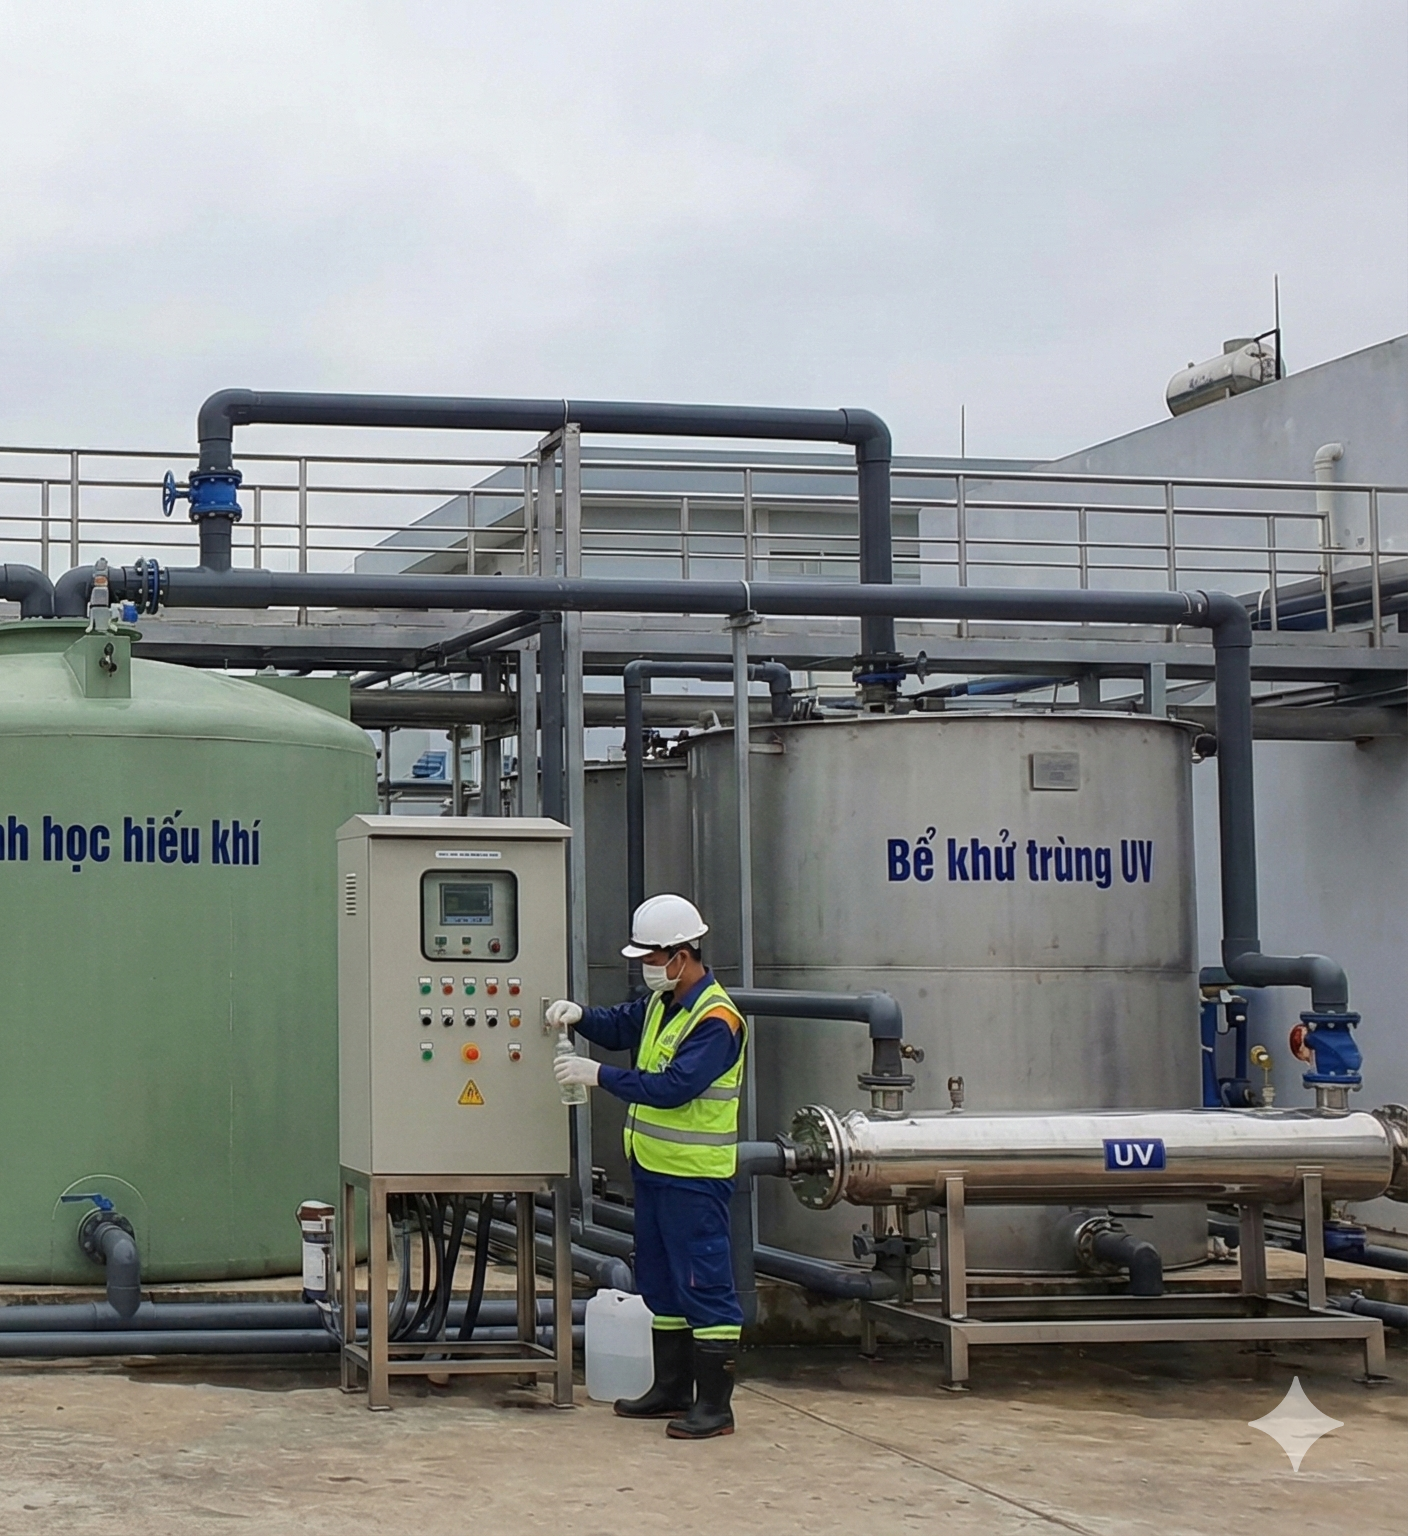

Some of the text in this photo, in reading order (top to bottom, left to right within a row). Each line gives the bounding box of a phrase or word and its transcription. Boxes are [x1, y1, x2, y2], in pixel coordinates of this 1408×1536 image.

[43, 815, 109, 872] học
[123, 810, 199, 864] hiếu
[211, 819, 261, 865] khí
[887, 827, 1153, 889] Bể khử trùng UV
[1114, 1143, 1154, 1166] UV
